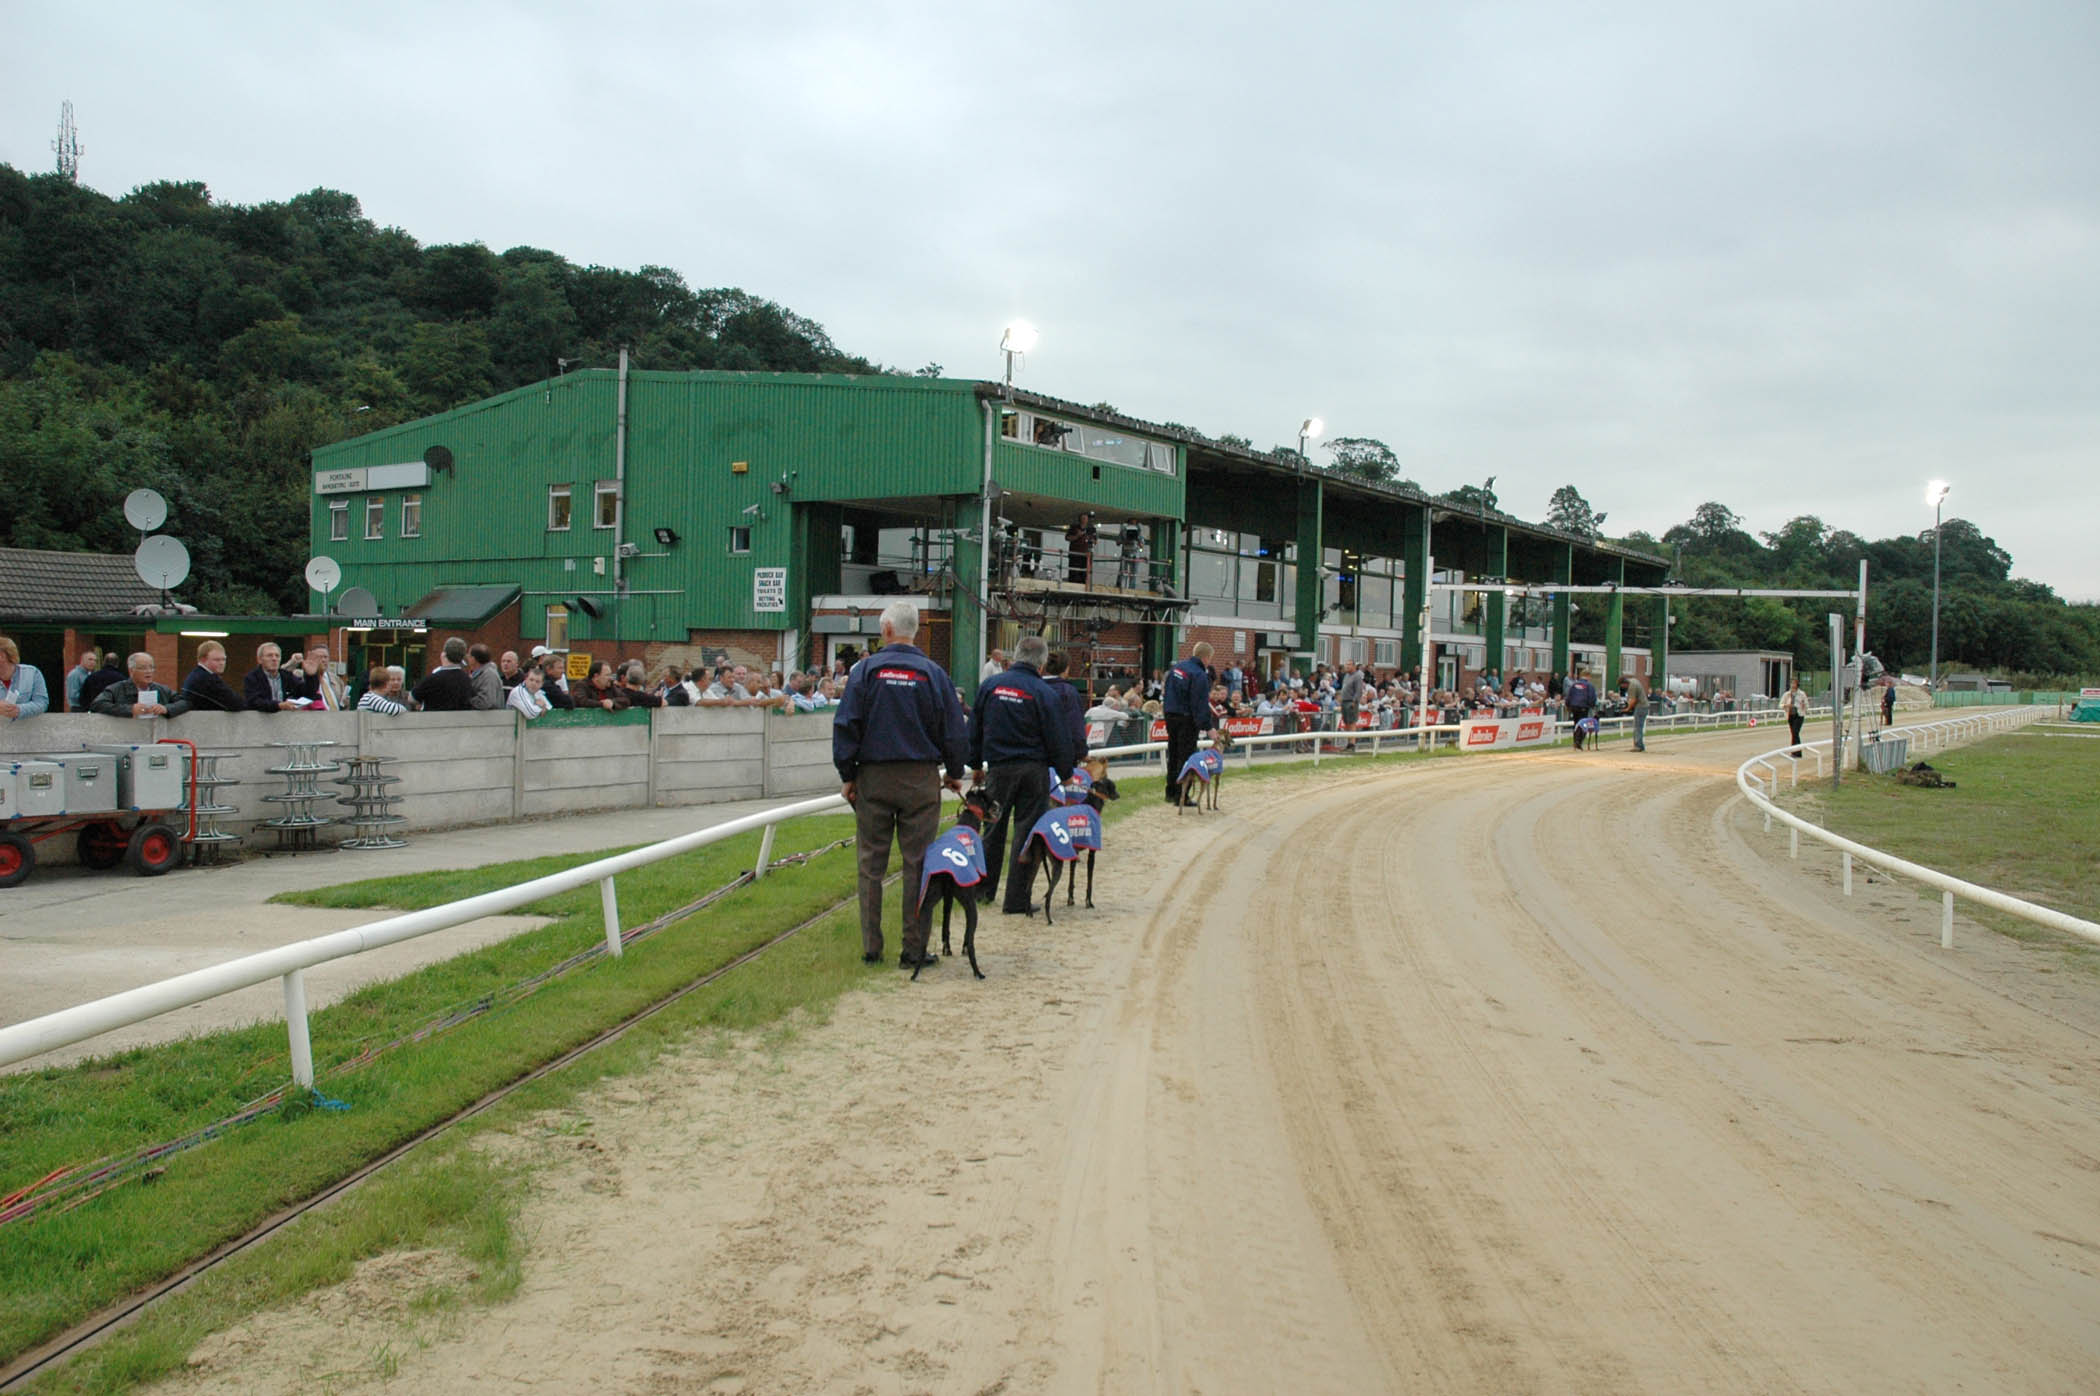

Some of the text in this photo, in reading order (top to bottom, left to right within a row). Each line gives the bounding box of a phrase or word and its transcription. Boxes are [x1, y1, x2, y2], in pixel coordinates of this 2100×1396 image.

[353, 619, 426, 627] MAIN ENTRANCE
[879, 671, 909, 680] Ladbrokes
[1225, 720, 1258, 733] Ladbrokes
[1050, 822, 1070, 845] 5
[941, 847, 969, 867] 6
